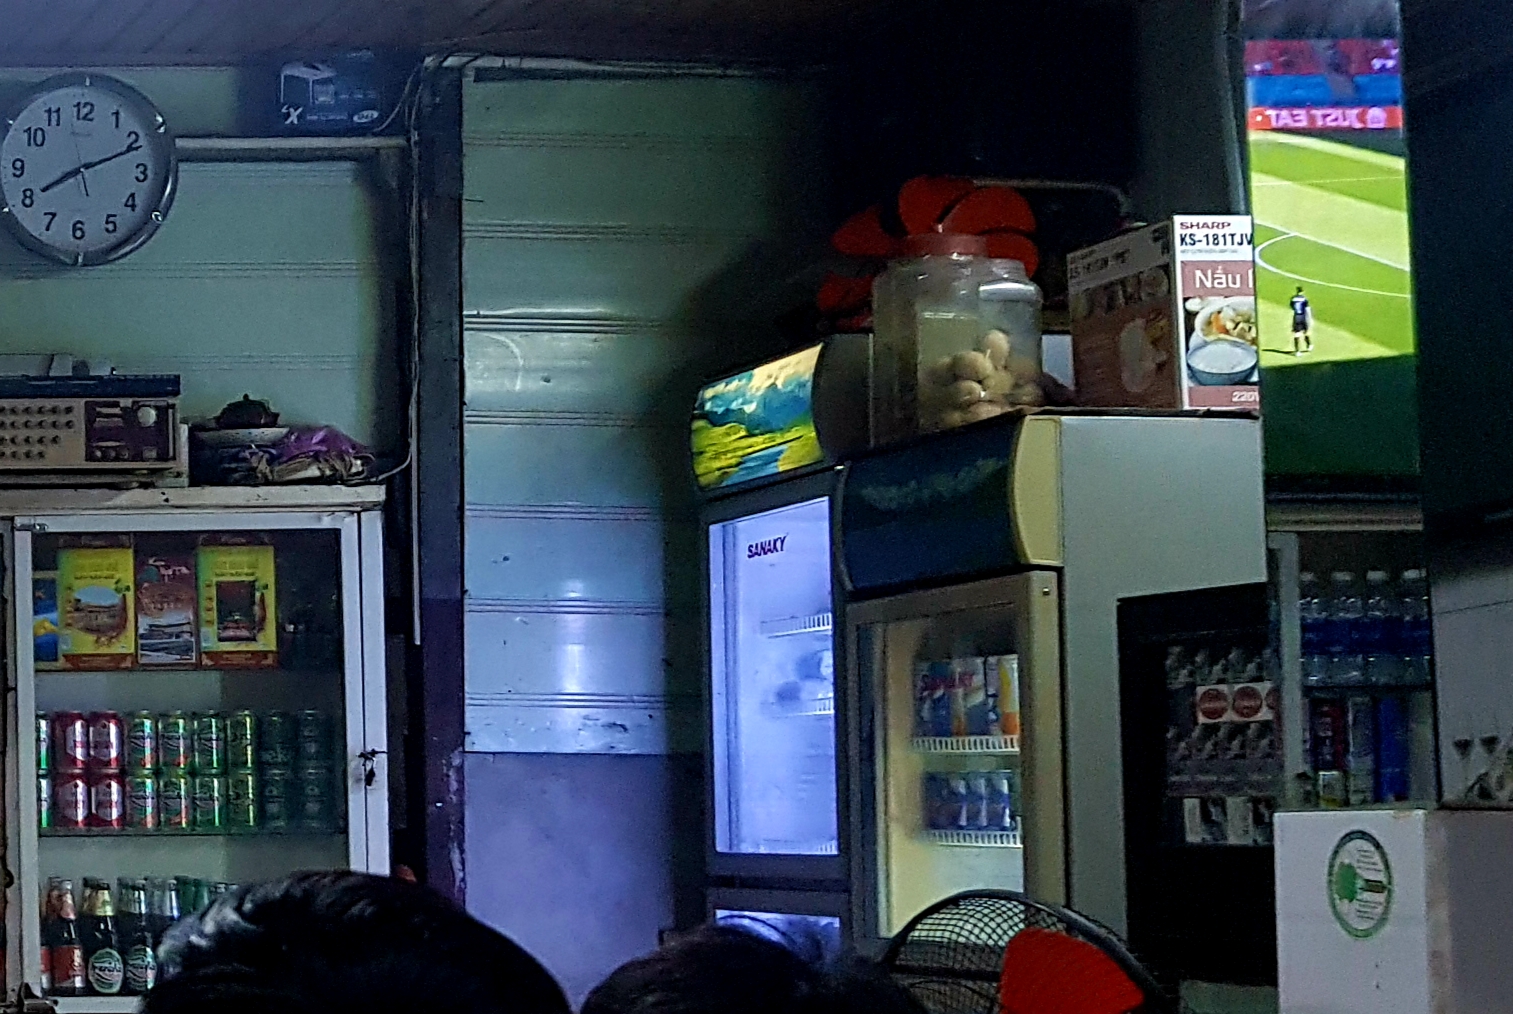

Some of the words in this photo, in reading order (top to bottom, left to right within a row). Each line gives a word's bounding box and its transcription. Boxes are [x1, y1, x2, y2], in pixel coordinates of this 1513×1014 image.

[44, 106, 61, 127] 11
[73, 101, 95, 121] 12
[111, 109, 120, 128] 1
[23, 126, 46, 147] 10
[126, 131, 140, 152] 2
[11, 157, 25, 178] 9
[134, 162, 148, 182] 3
[21, 188, 34, 208] 8
[124, 192, 137, 212] 4
[43, 212, 57, 231] 7
[71, 219, 85, 240] 6
[105, 213, 117, 234] 5
[1179, 221, 1231, 230] SHARP
[747, 535, 788, 559] SANAKY
